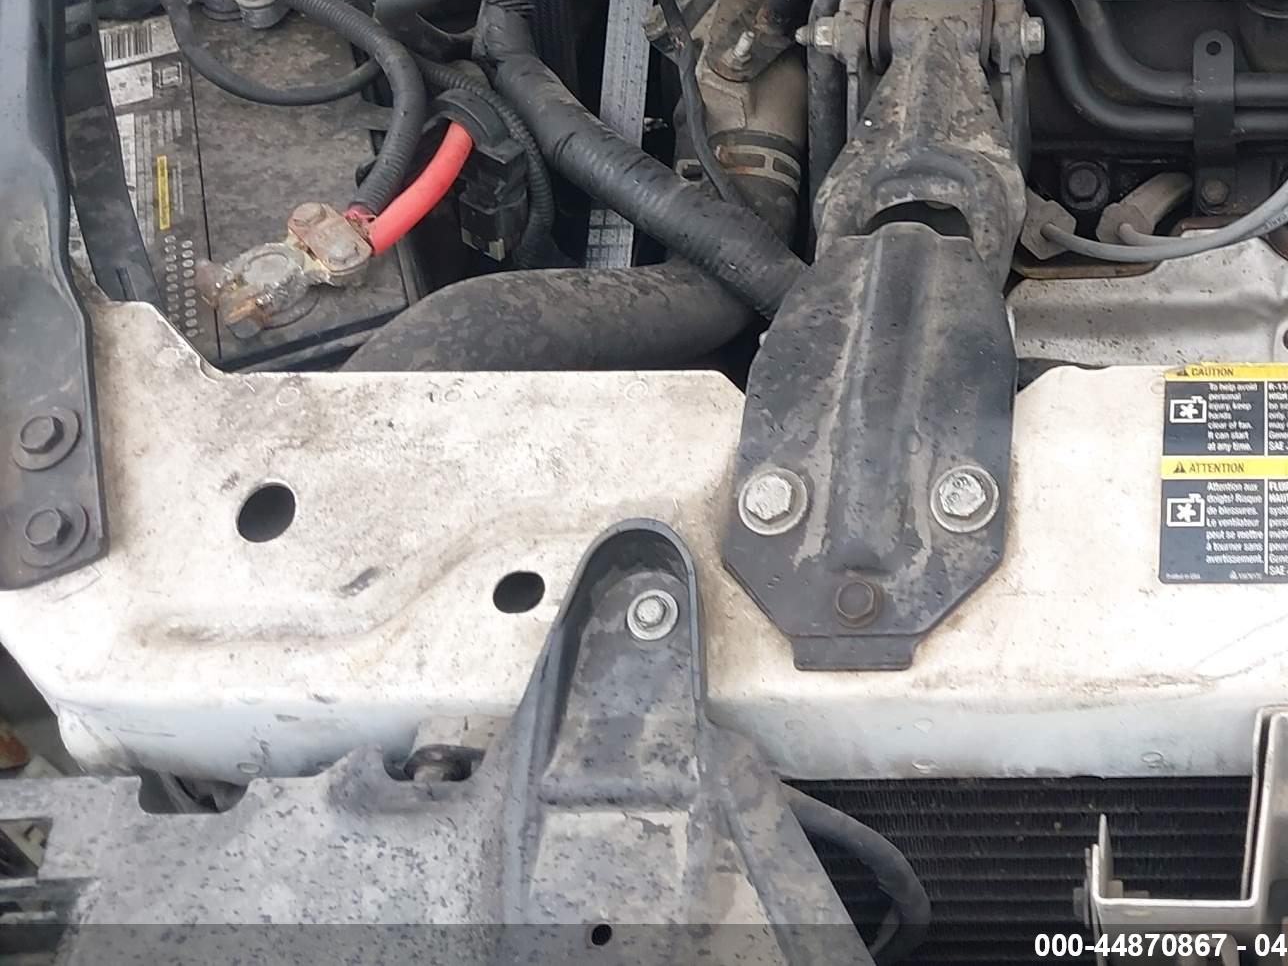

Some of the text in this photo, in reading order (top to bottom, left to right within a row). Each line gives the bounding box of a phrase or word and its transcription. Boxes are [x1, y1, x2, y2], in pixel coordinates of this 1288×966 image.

[1191, 367, 1233, 376] CAUTION
[1269, 442, 1284, 451] SAE
[1189, 463, 1245, 473] ATTENTION
[1269, 566, 1286, 575] SAE
